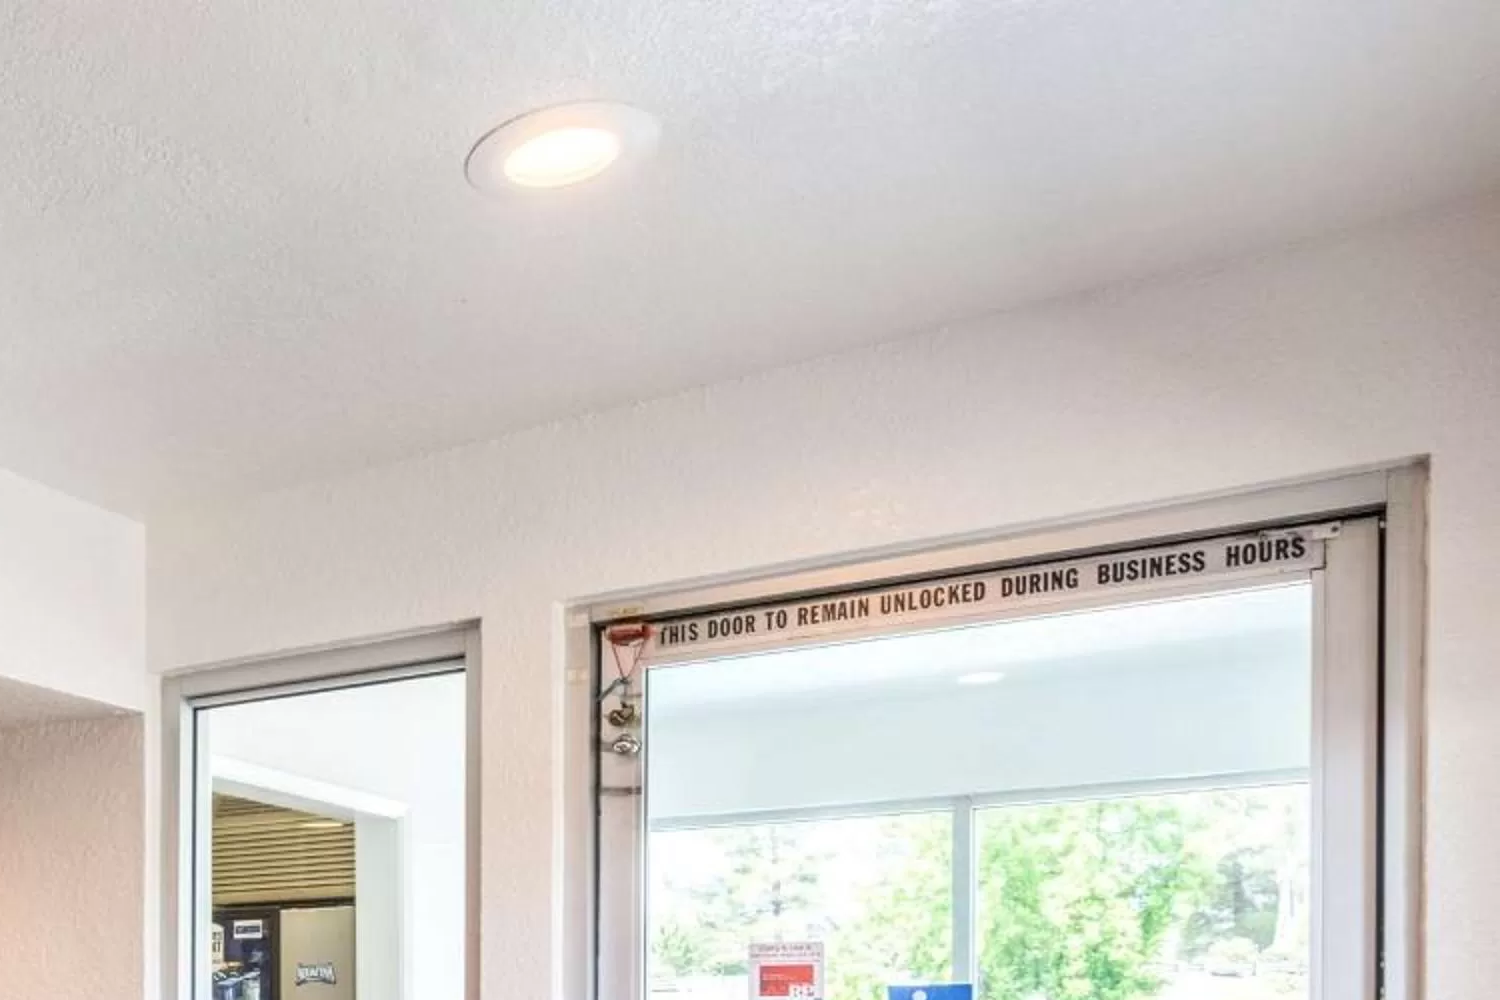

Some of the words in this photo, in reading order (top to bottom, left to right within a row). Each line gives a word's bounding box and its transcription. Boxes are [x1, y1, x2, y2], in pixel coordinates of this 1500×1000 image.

[659, 622, 699, 646] THIS
[707, 615, 756, 639] DOOR
[765, 610, 788, 632] TO
[797, 597, 870, 626] REMAIN
[880, 581, 986, 614] UNLOCKED
[1001, 567, 1079, 598] DURING
[1097, 551, 1206, 584] BUSINESS
[1225, 536, 1307, 568] HOURS
